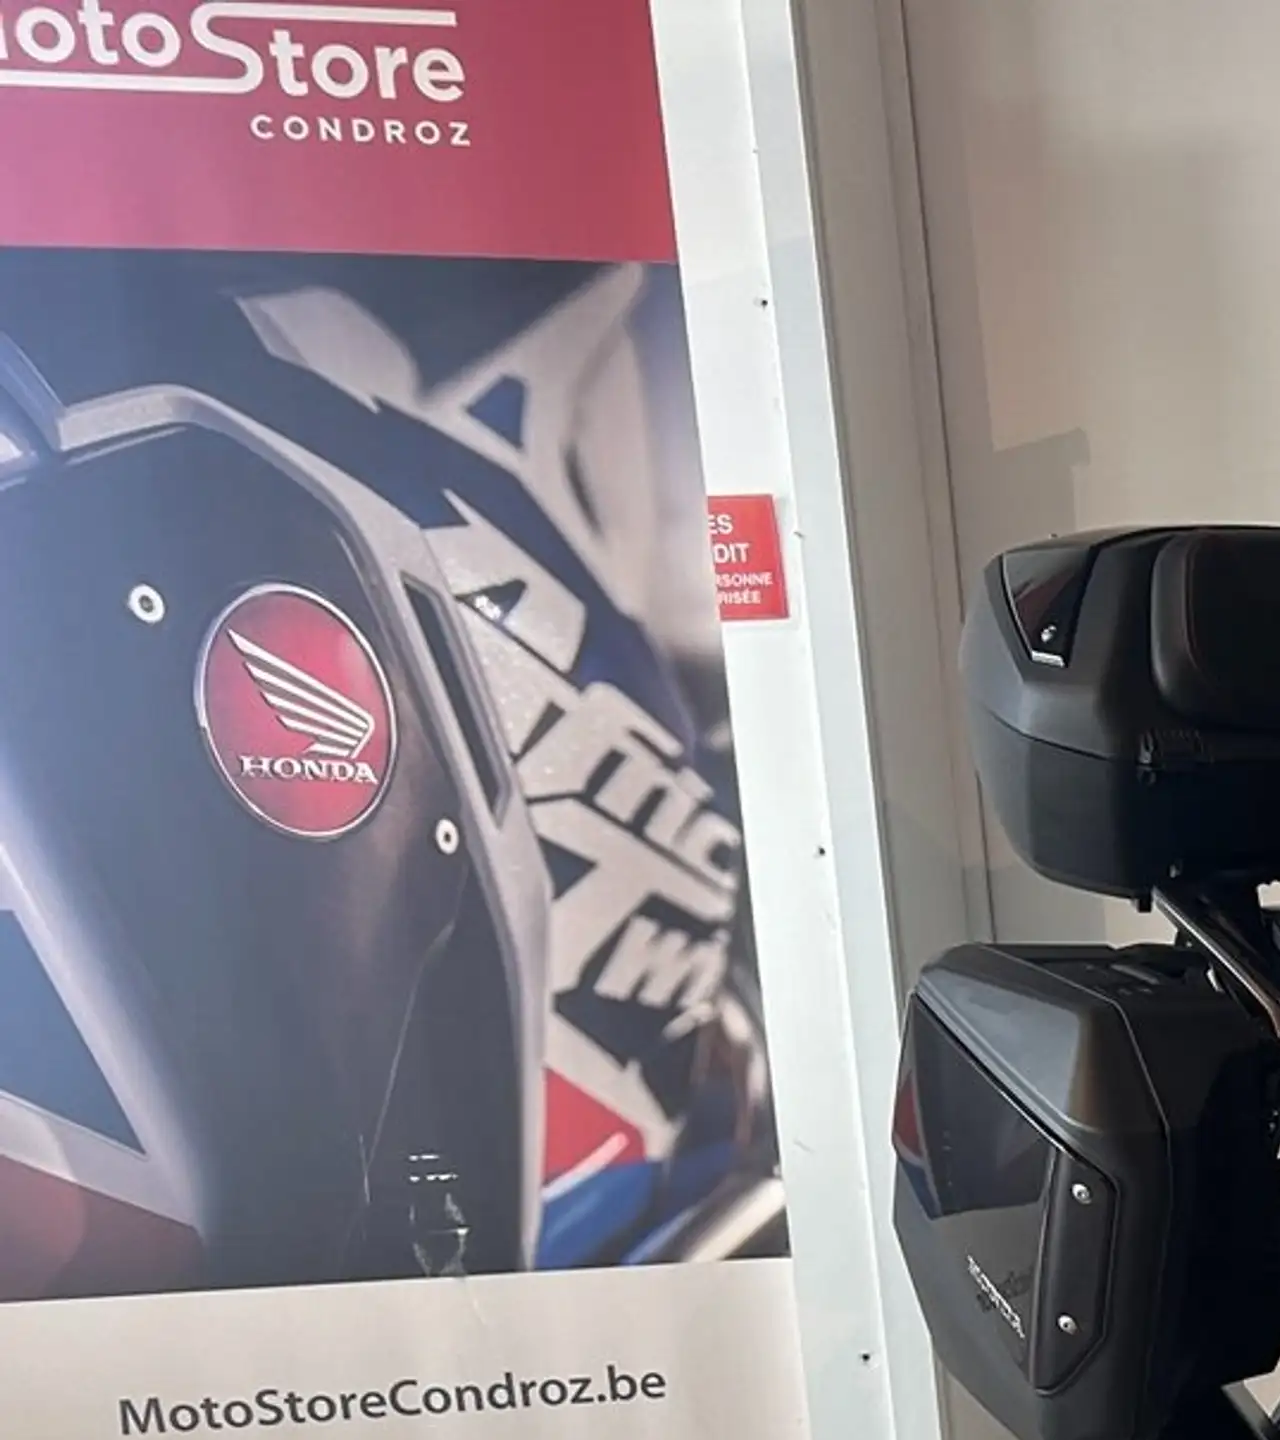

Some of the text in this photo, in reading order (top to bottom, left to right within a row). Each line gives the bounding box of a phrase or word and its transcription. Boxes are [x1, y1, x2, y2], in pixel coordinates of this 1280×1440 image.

[0, 0, 466, 102] otoStore
[249, 113, 471, 147] CONDROZ
[239, 754, 379, 786] HONDA
[118, 1365, 667, 1436] MotoStoreCondroz.be
